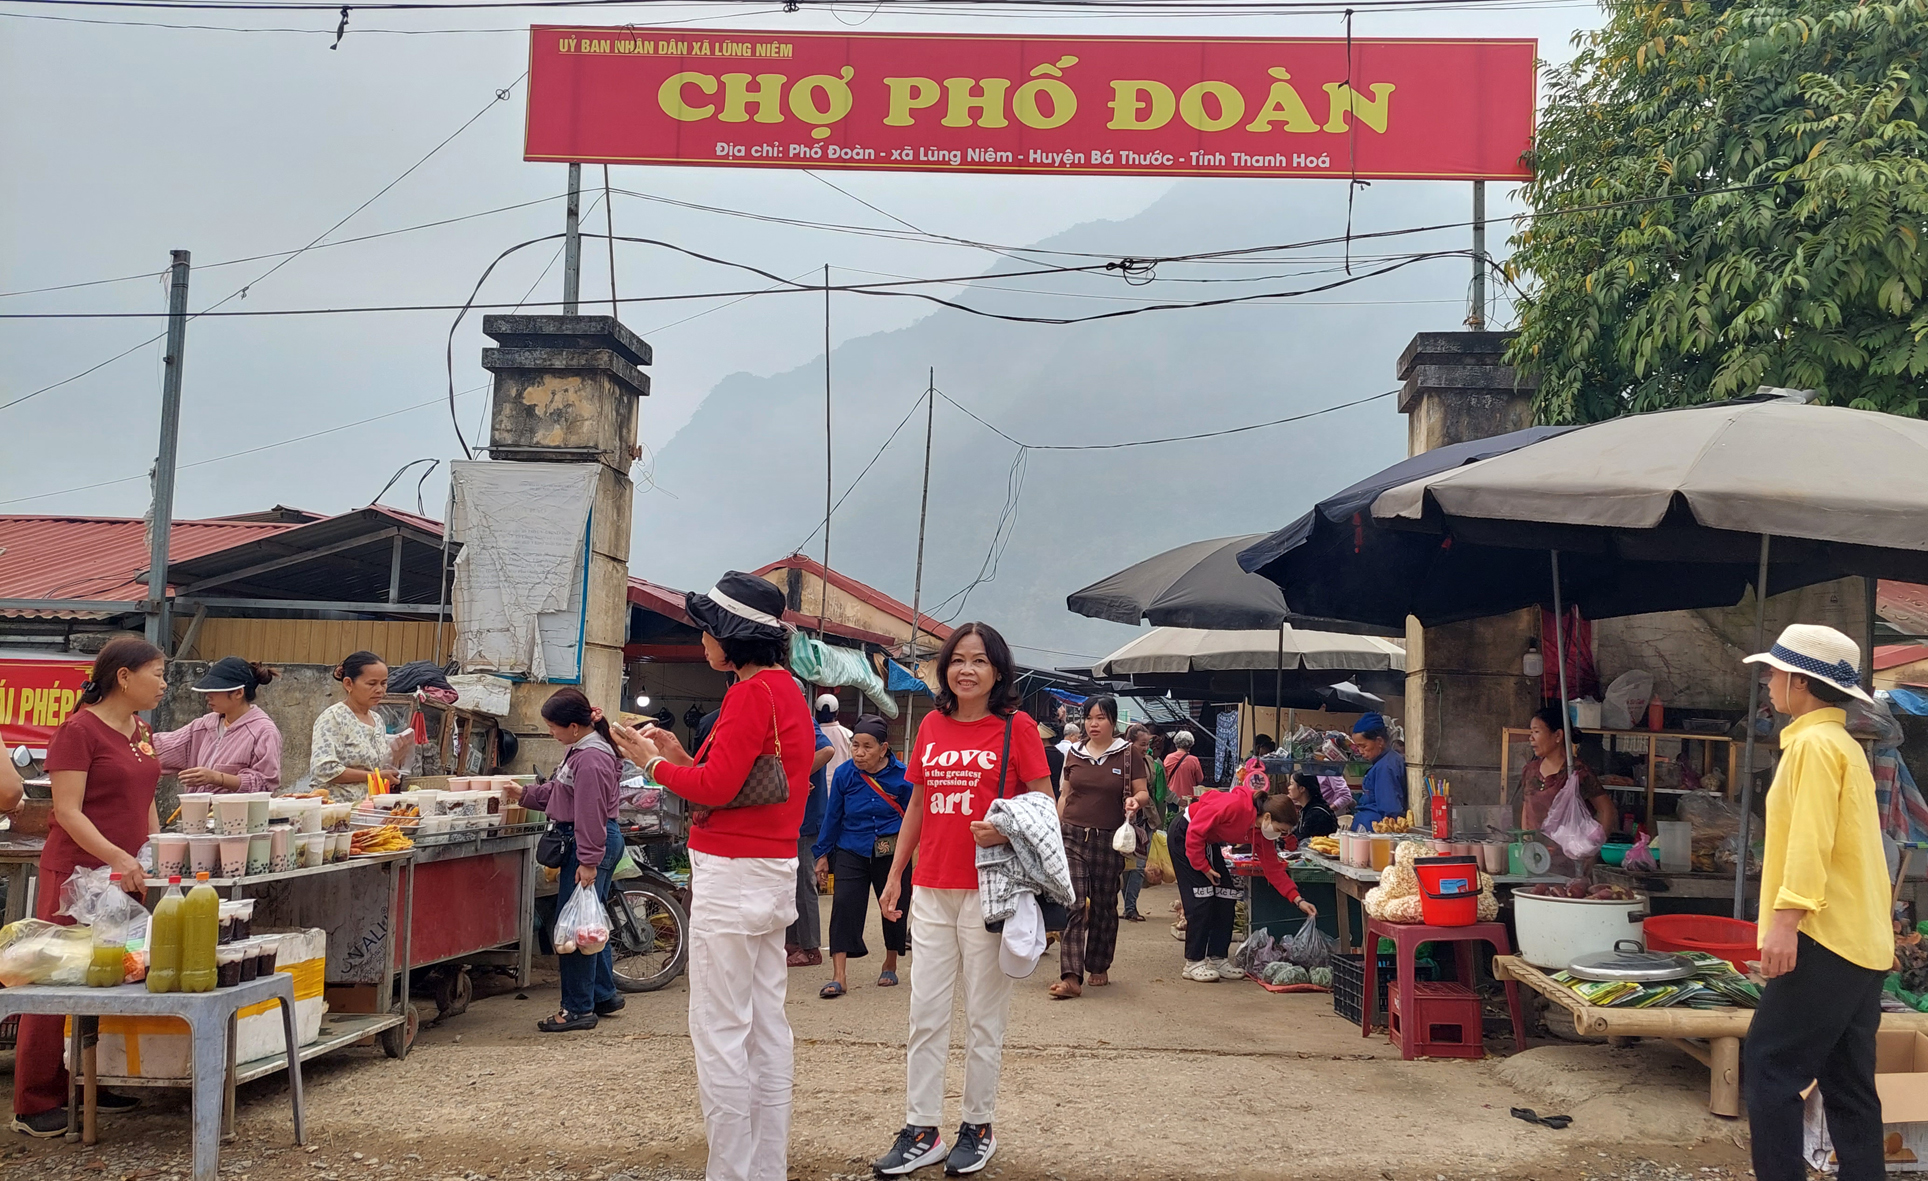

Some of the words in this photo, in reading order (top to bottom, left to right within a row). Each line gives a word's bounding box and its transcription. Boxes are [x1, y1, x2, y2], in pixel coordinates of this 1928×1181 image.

[560, 34, 577, 52] UỶ
[581, 39, 610, 53] BAN
[614, 38, 654, 54] NHÂN
[658, 39, 688, 55] DÂN
[691, 40, 711, 55] XÃ
[715, 40, 752, 56] LŨNG
[756, 41, 793, 57] NIÊM
[658, 65, 855, 139] CHỢ
[883, 55, 1079, 129] PHỐ
[1106, 66, 1396, 134] ĐOÀN
[716, 142, 745, 160] Địa
[751, 141, 783, 158] chỉ:
[789, 142, 824, 159] Phố
[828, 144, 875, 160] Đoàn
[890, 146, 913, 161] xã
[919, 146, 961, 165] Lũng
[967, 148, 1012, 163] Niêm
[1029, 149, 1084, 168] Huyện
[1091, 149, 1114, 165] Bá
[1120, 150, 1174, 166] Thước
[1190, 150, 1226, 166] Tỉnh
[1231, 152, 1287, 167] Thanh
[1292, 152, 1330, 168] Hoá
[921, 742, 997, 770] Love
[931, 769, 945, 777] the
[968, 779, 980, 787] of
[930, 789, 974, 816] art
